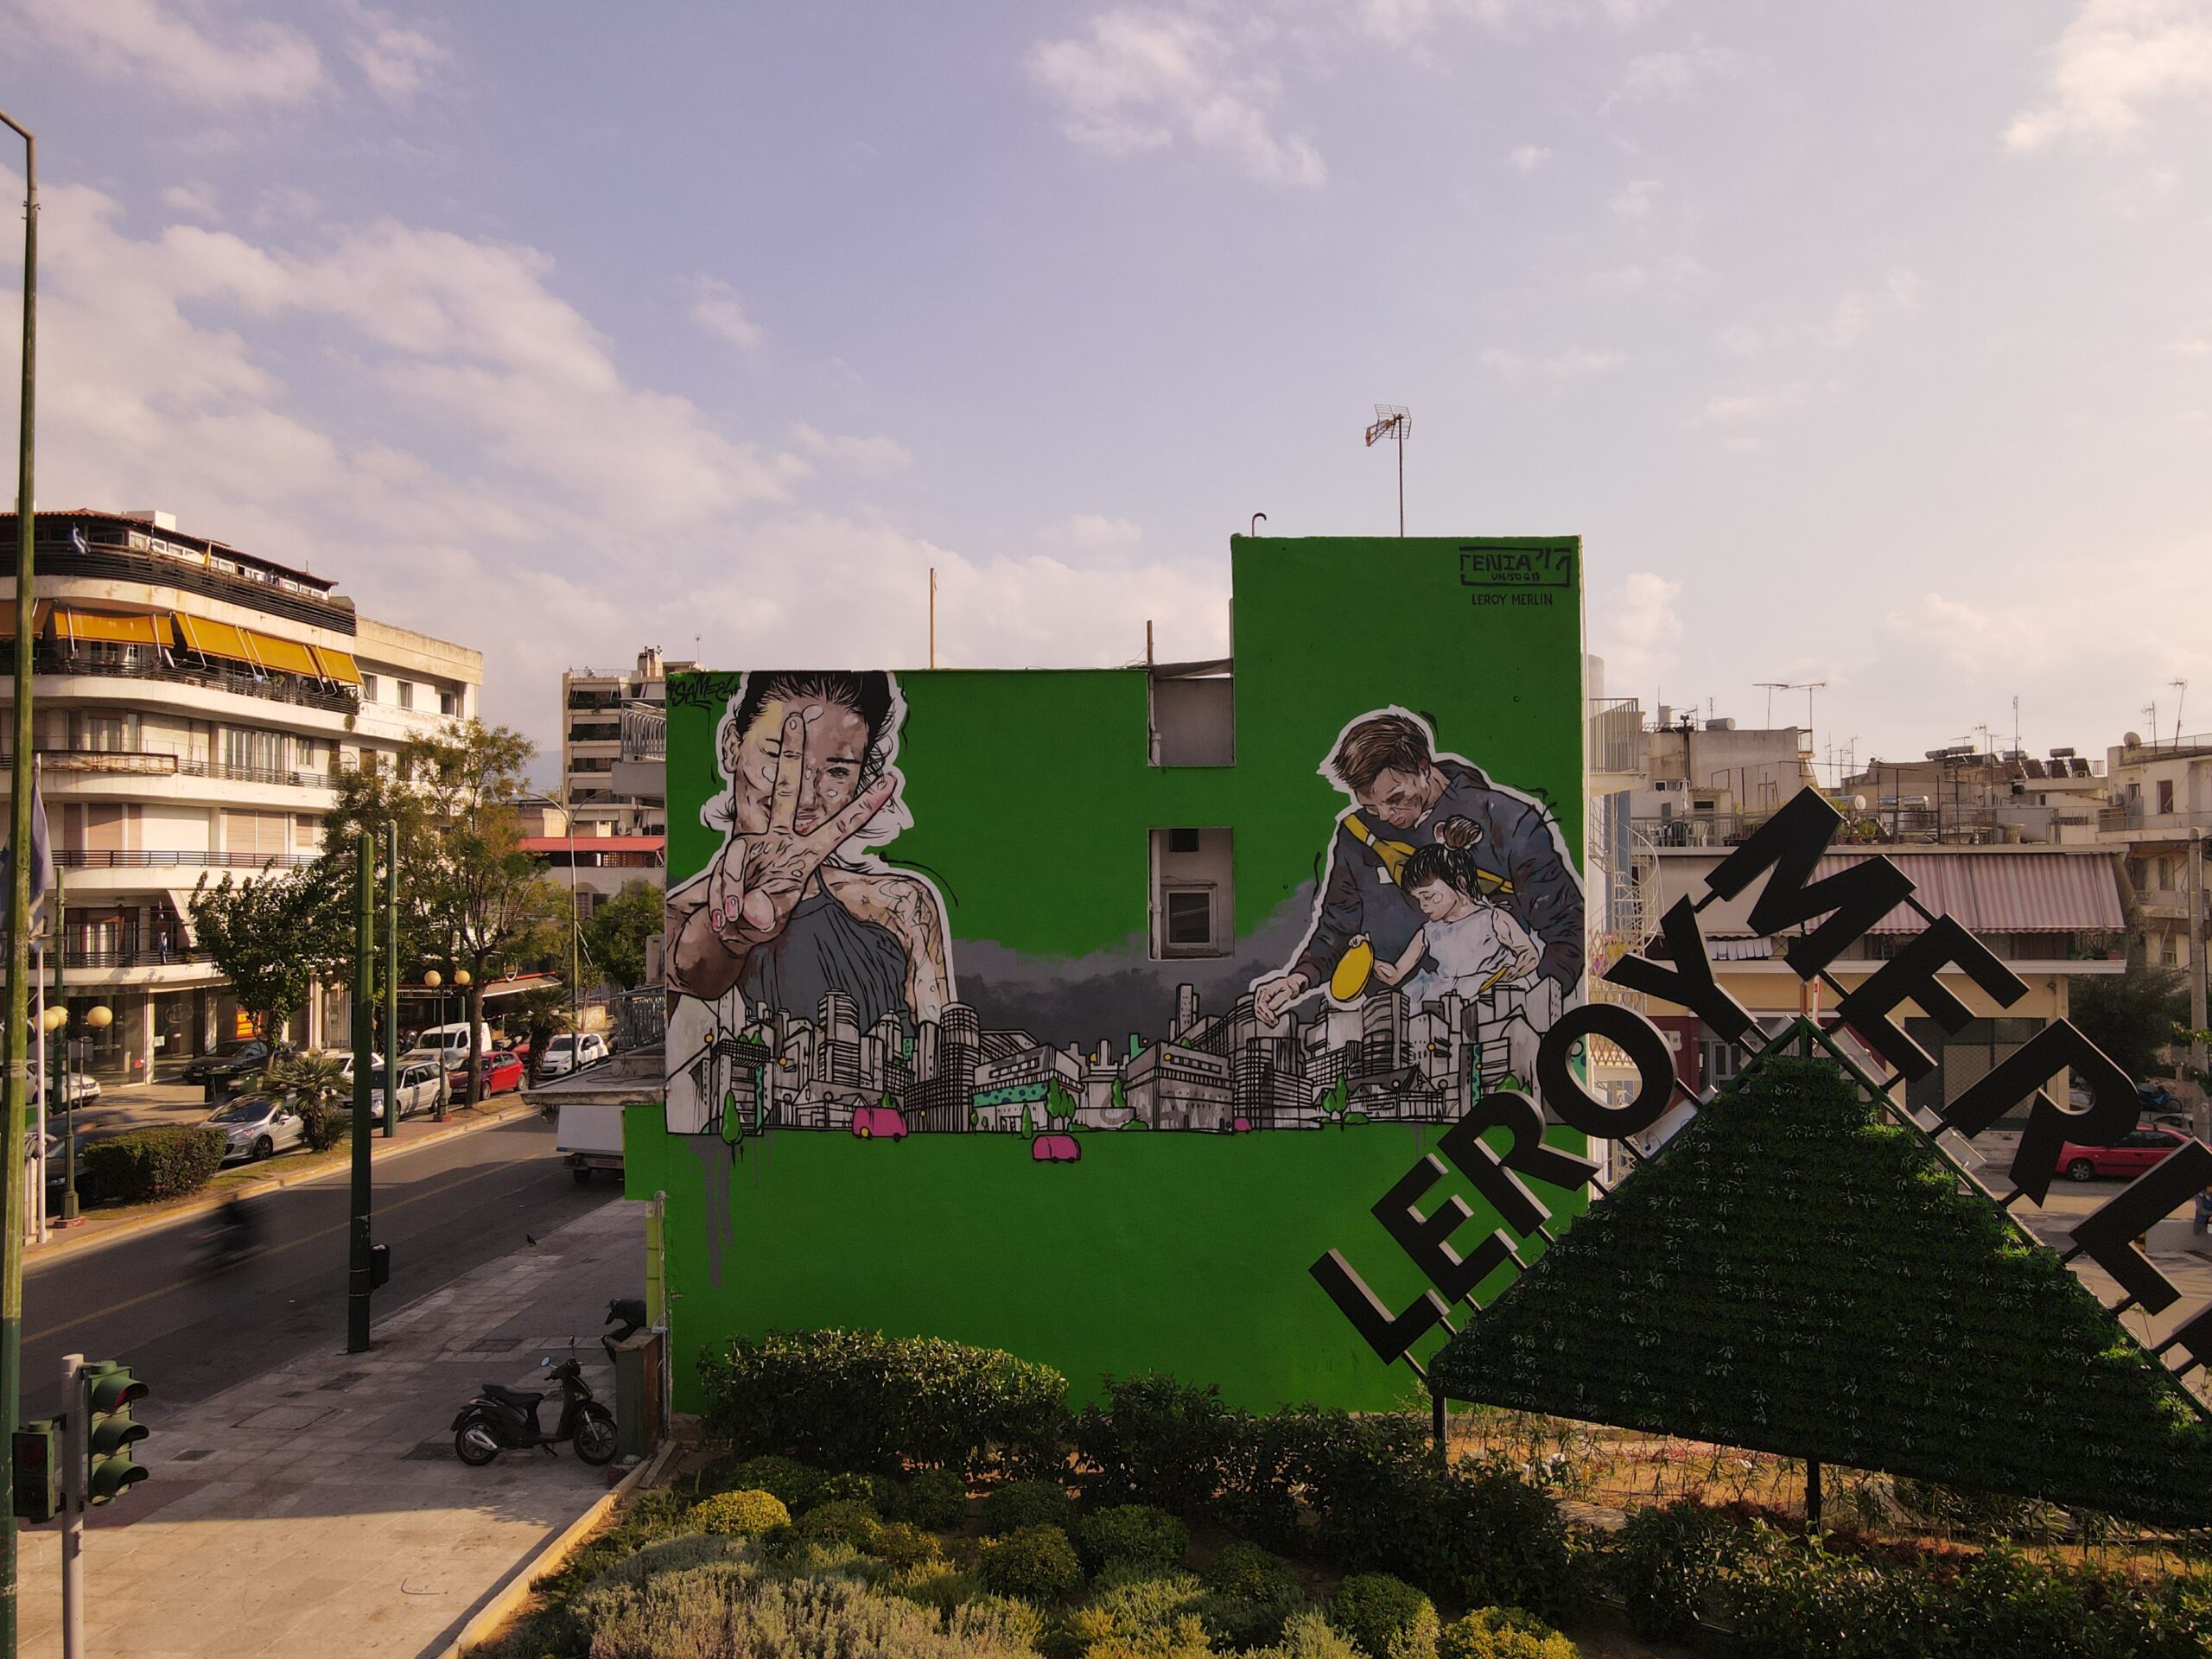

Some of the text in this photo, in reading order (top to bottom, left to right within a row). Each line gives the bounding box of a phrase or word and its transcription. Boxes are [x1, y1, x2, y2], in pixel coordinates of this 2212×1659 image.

[1472, 594, 1553, 605] LEROY MERLIN
[1308, 786, 2212, 1368] LEROY MERL
